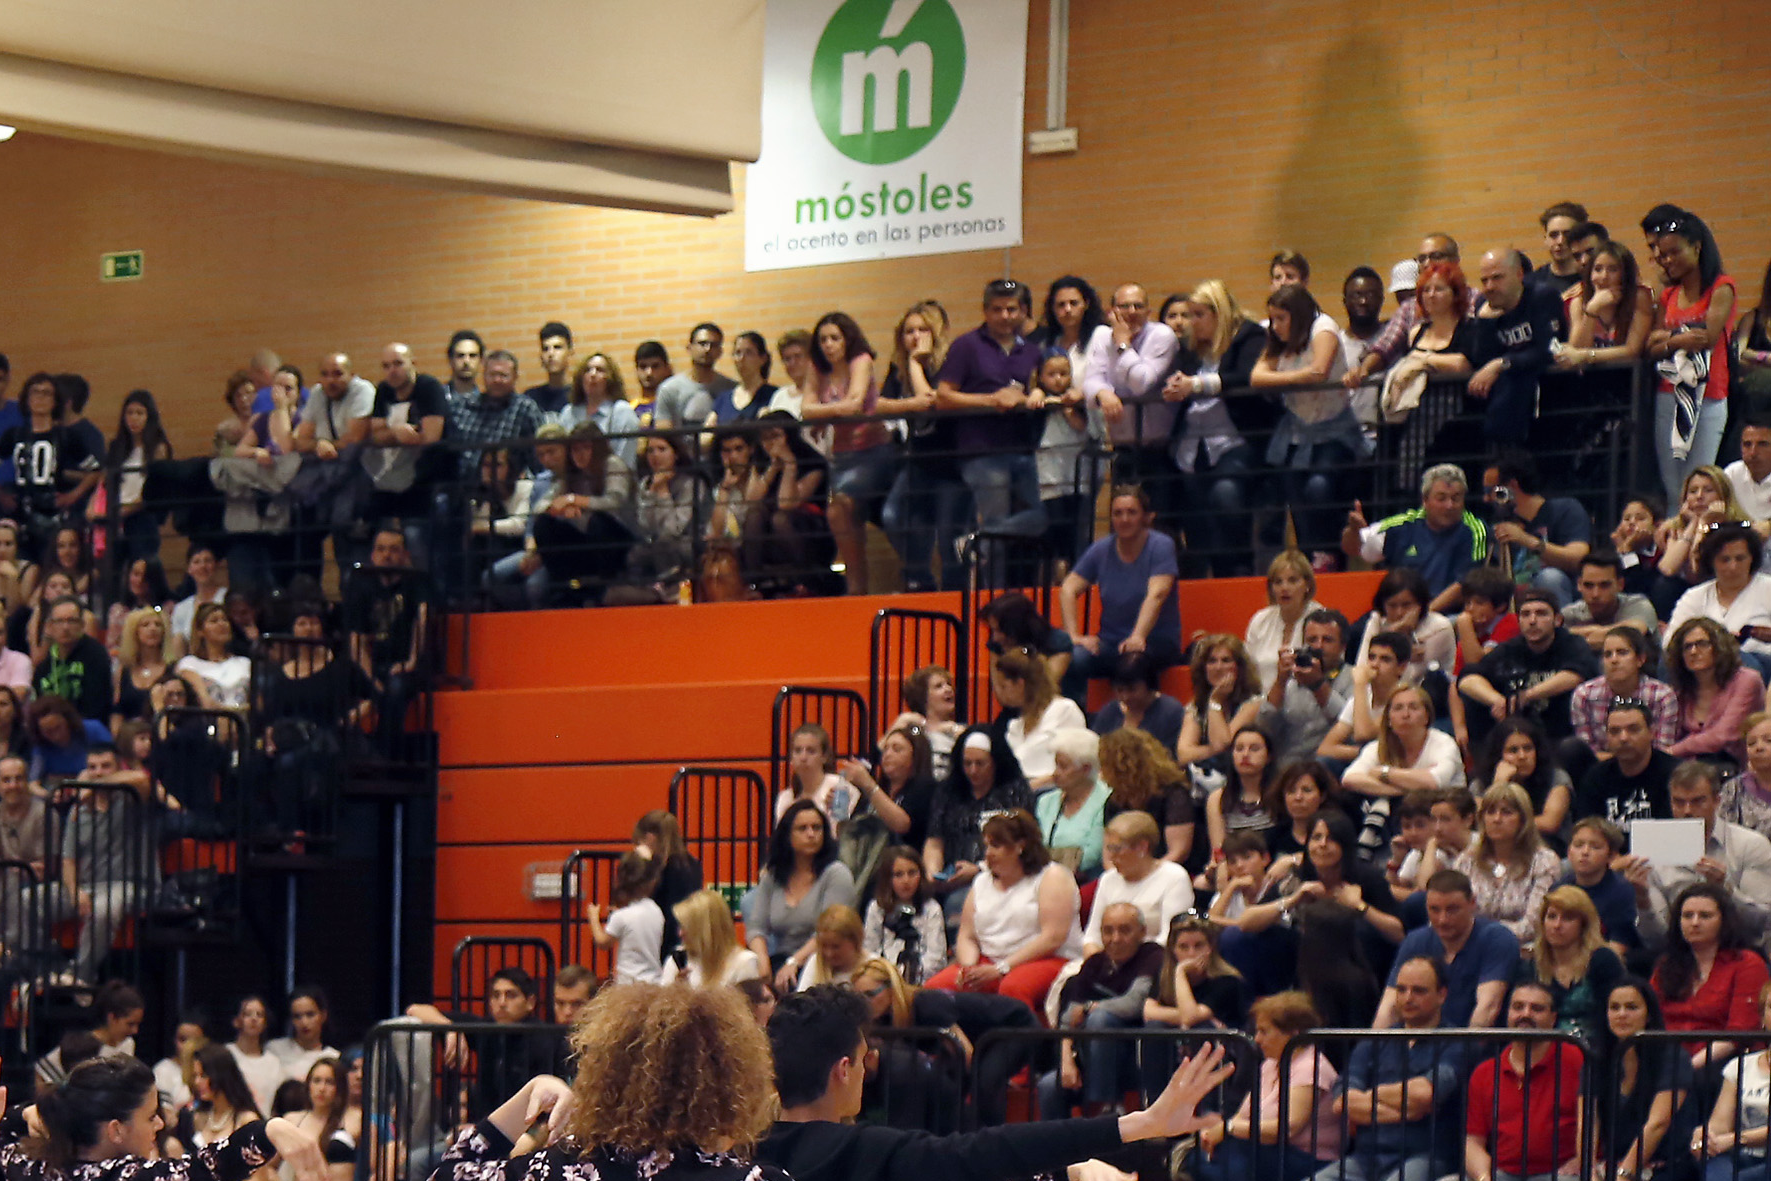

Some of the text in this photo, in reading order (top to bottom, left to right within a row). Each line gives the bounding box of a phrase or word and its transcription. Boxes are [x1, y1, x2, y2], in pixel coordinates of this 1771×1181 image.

[795, 172, 975, 224] móstoles
[763, 216, 1006, 252] el acento en las personas
